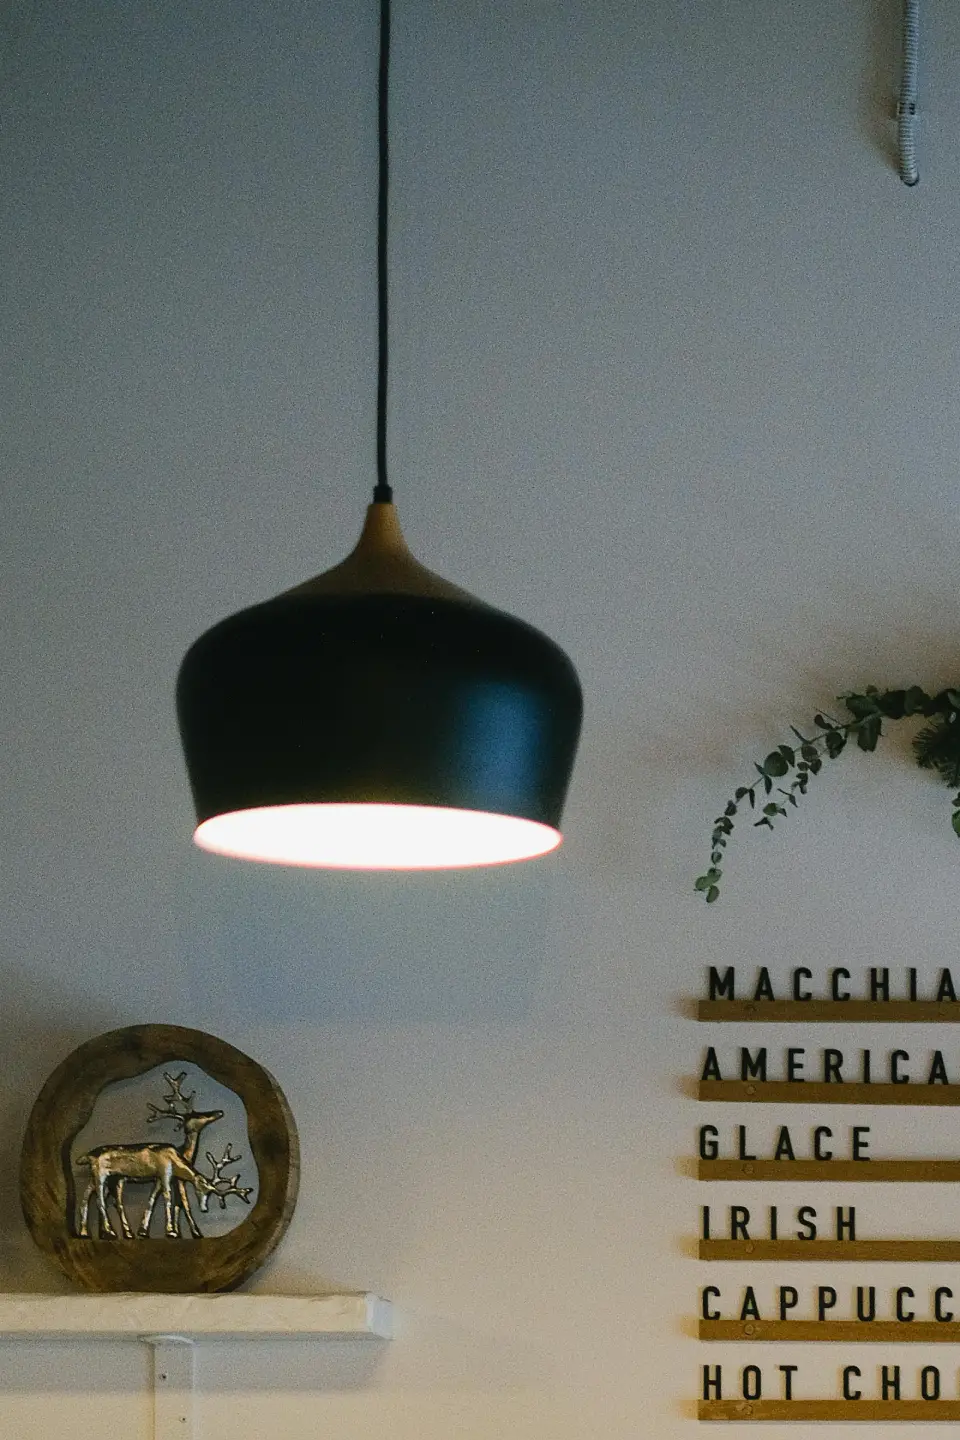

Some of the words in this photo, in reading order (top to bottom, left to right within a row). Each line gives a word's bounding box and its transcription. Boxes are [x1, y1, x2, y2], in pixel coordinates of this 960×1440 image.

[700, 1125, 871, 1161] GLACE
[702, 1205, 856, 1241] IRISH
[703, 1364, 798, 1400] HOT
